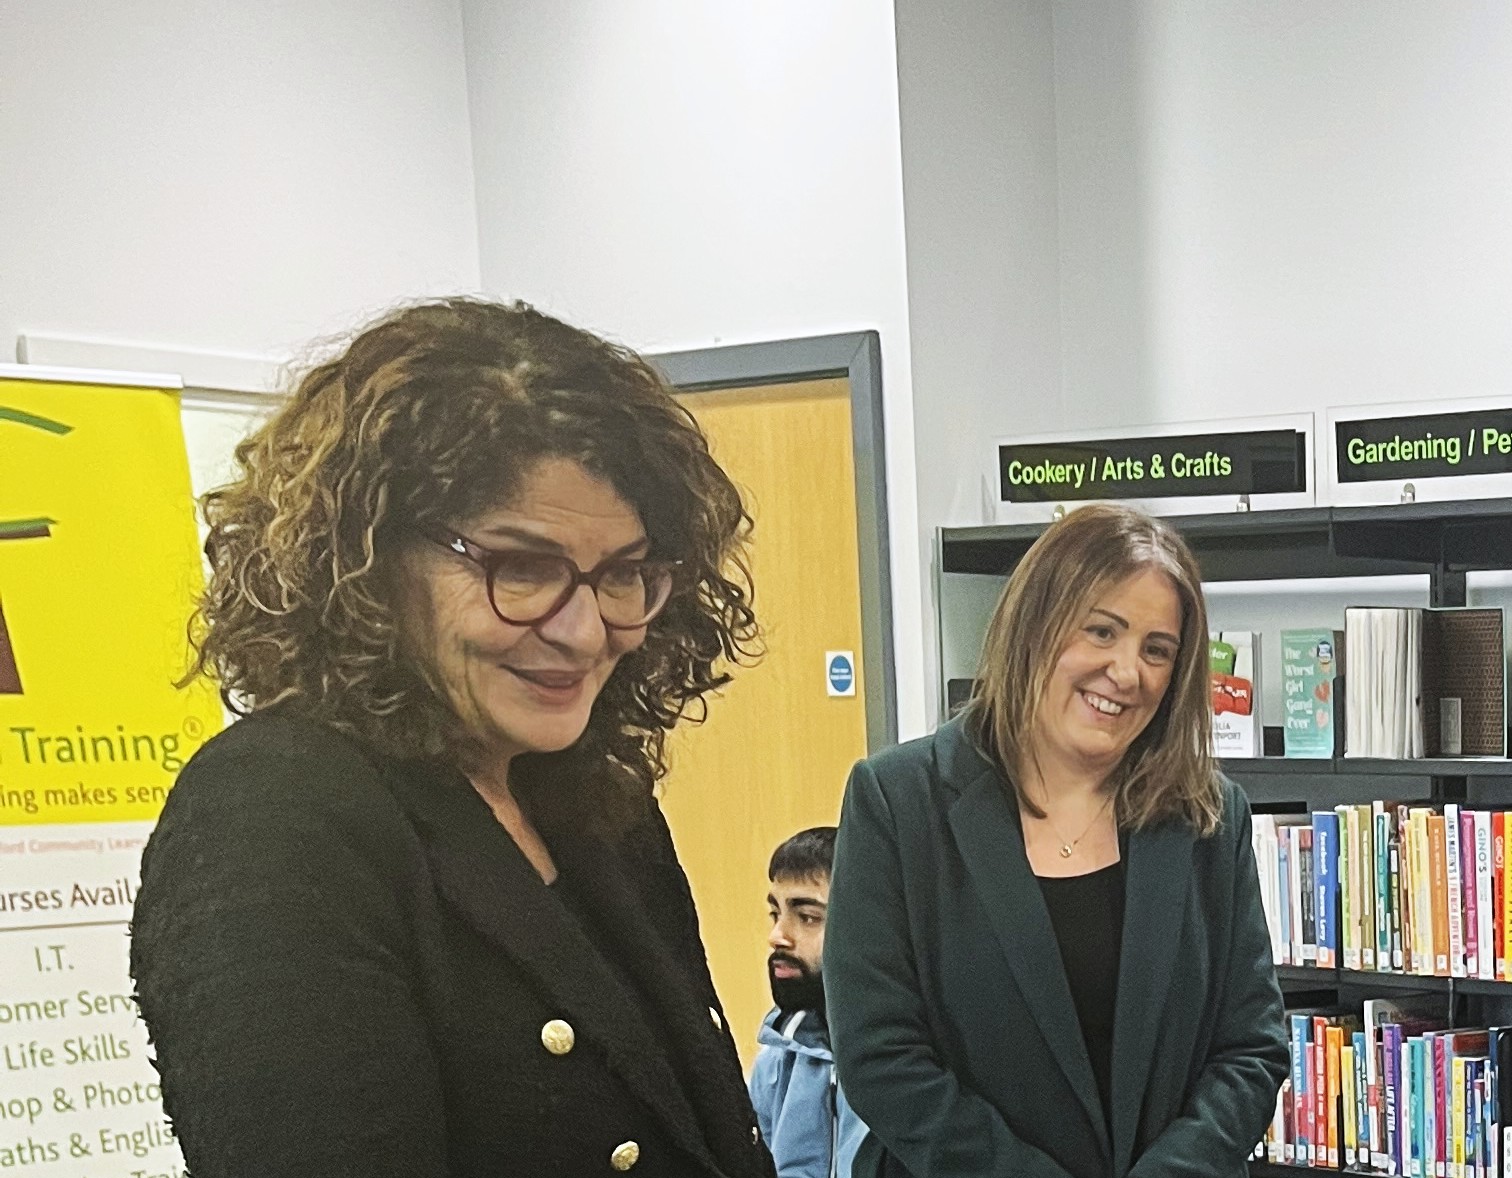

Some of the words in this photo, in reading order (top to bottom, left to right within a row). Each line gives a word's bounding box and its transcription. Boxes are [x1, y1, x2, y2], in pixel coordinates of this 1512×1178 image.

[1347, 433, 1460, 464] Gardening
[1468, 429, 1475, 457] /
[1008, 459, 1085, 488] Cookery
[1090, 457, 1097, 482] /
[1102, 456, 1144, 482] Arts
[1150, 453, 1165, 479] &
[1171, 452, 1232, 478] Crafts
[45, 782, 118, 806] makes
[1478, 828, 1487, 873] GINO'S
[1495, 836, 1503, 868] GINO'S
[34, 945, 75, 973] I.T.
[6, 1044, 54, 1070] Life
[64, 1034, 130, 1064] Skills
[53, 1087, 77, 1114] &
[84, 1081, 162, 1109] Photo
[1387, 1086, 1395, 1103] LIFE
[1387, 1105, 1395, 1131] AFTER
[70, 1132, 92, 1158] &
